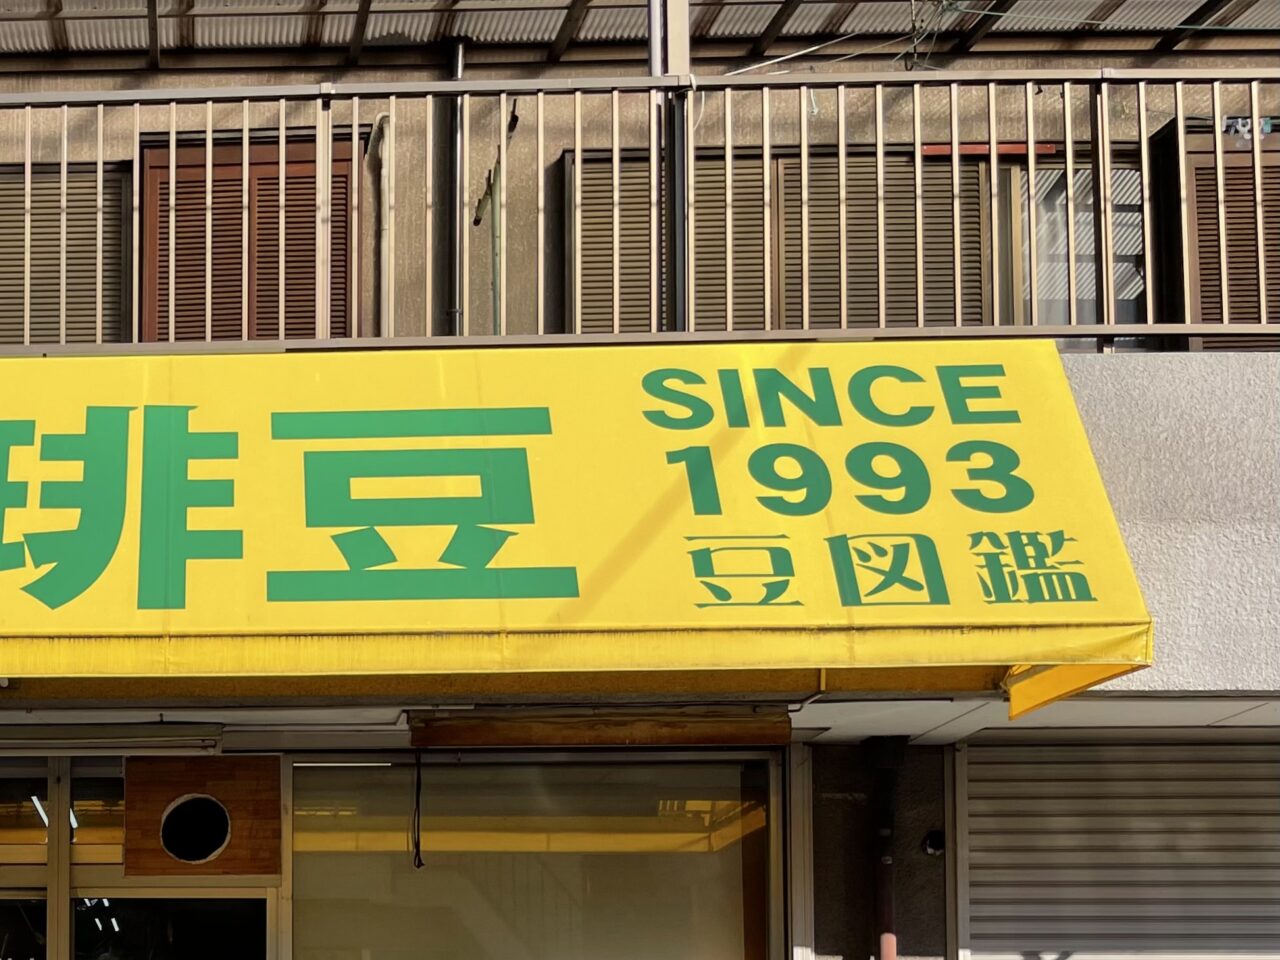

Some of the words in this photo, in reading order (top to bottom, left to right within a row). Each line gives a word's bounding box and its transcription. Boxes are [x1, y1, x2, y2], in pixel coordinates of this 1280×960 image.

[642, 364, 1021, 430] SINCE
[666, 440, 1035, 516] 1993
[682, 530, 1098, 609] 豆図鑑
